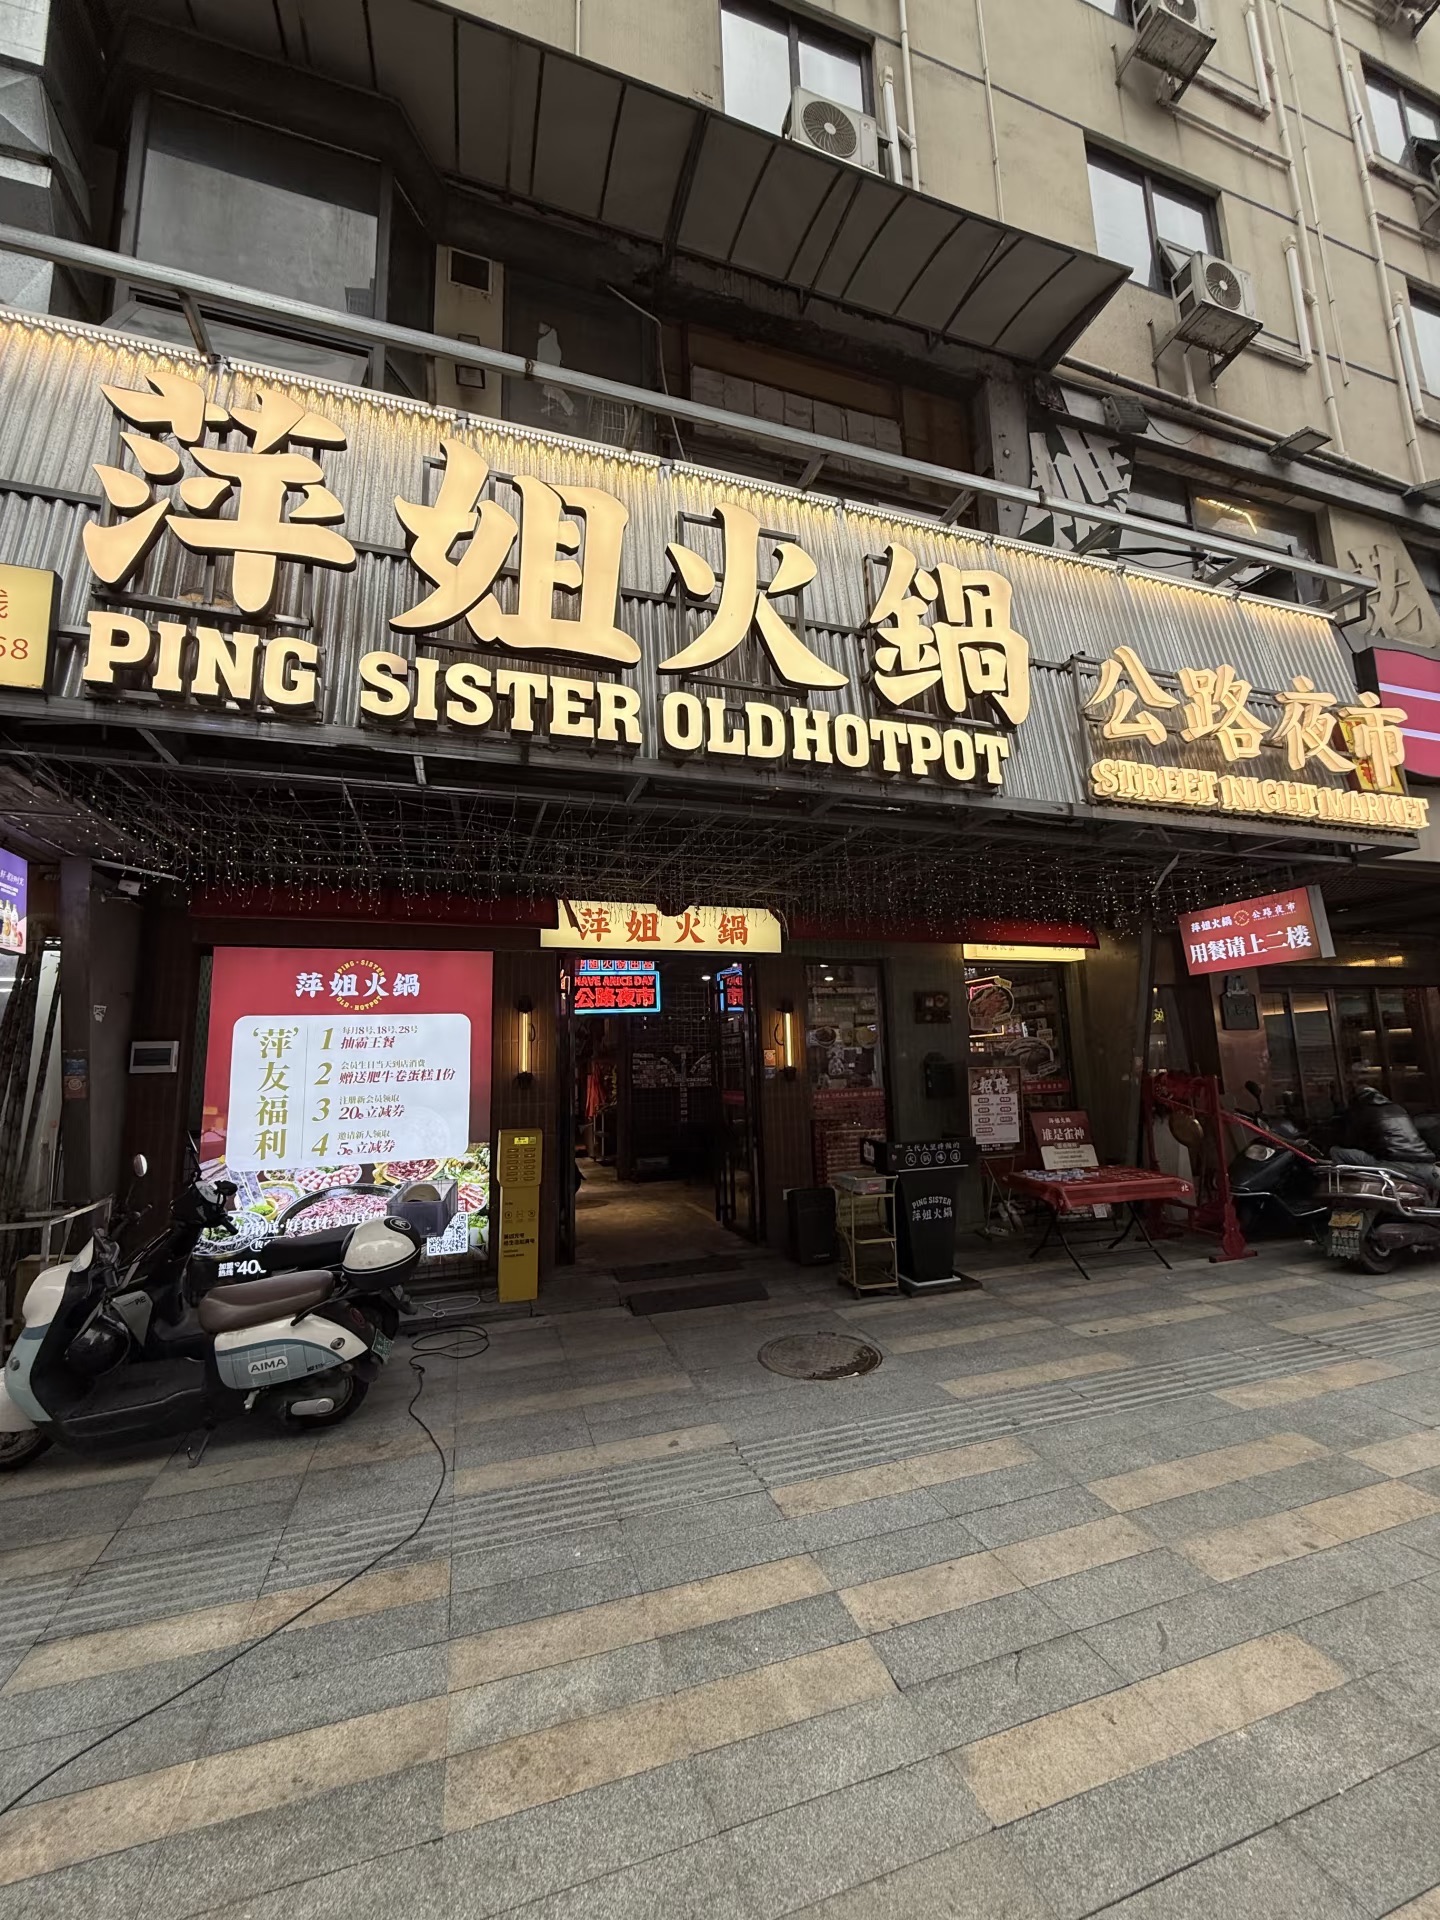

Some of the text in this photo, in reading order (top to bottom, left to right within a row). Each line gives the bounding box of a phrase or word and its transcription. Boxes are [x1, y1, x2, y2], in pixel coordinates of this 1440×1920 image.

[83, 371, 1030, 726] 萍姐火鍋
[83, 611, 322, 707] PING
[359, 650, 643, 745] SISTER
[1082, 645, 1408, 791] 公路夜市
[1091, 759, 1431, 829] STREET NIGHT MARKET
[1252, 902, 1296, 919] 公路夜市
[578, 907, 749, 945] 萍姐火鍋
[1190, 924, 1312, 964] 用餐请上二楼
[295, 972, 420, 998] 萍姐火鍋
[574, 976, 601, 986] HAVE
[634, 976, 655, 986] DAY
[575, 987, 655, 1008] 公路夜市
[320, 1028, 334, 1050] 1
[340, 1036, 396, 1049] 抽霸王餐
[313, 1062, 333, 1085] 2
[341, 1059, 426, 1069] 会员生日当天到店消费
[339, 1068, 456, 1084] 赠送肥牛卷蛋糕1份
[978, 1076, 1010, 1094] 招聘
[311, 1097, 331, 1122] 3
[311, 1133, 329, 1156] 4
[1042, 1127, 1085, 1141] 谁是雀神
[912, 1196, 952, 1209] PING SISTER
[251, 1358, 286, 1373] AIMA
